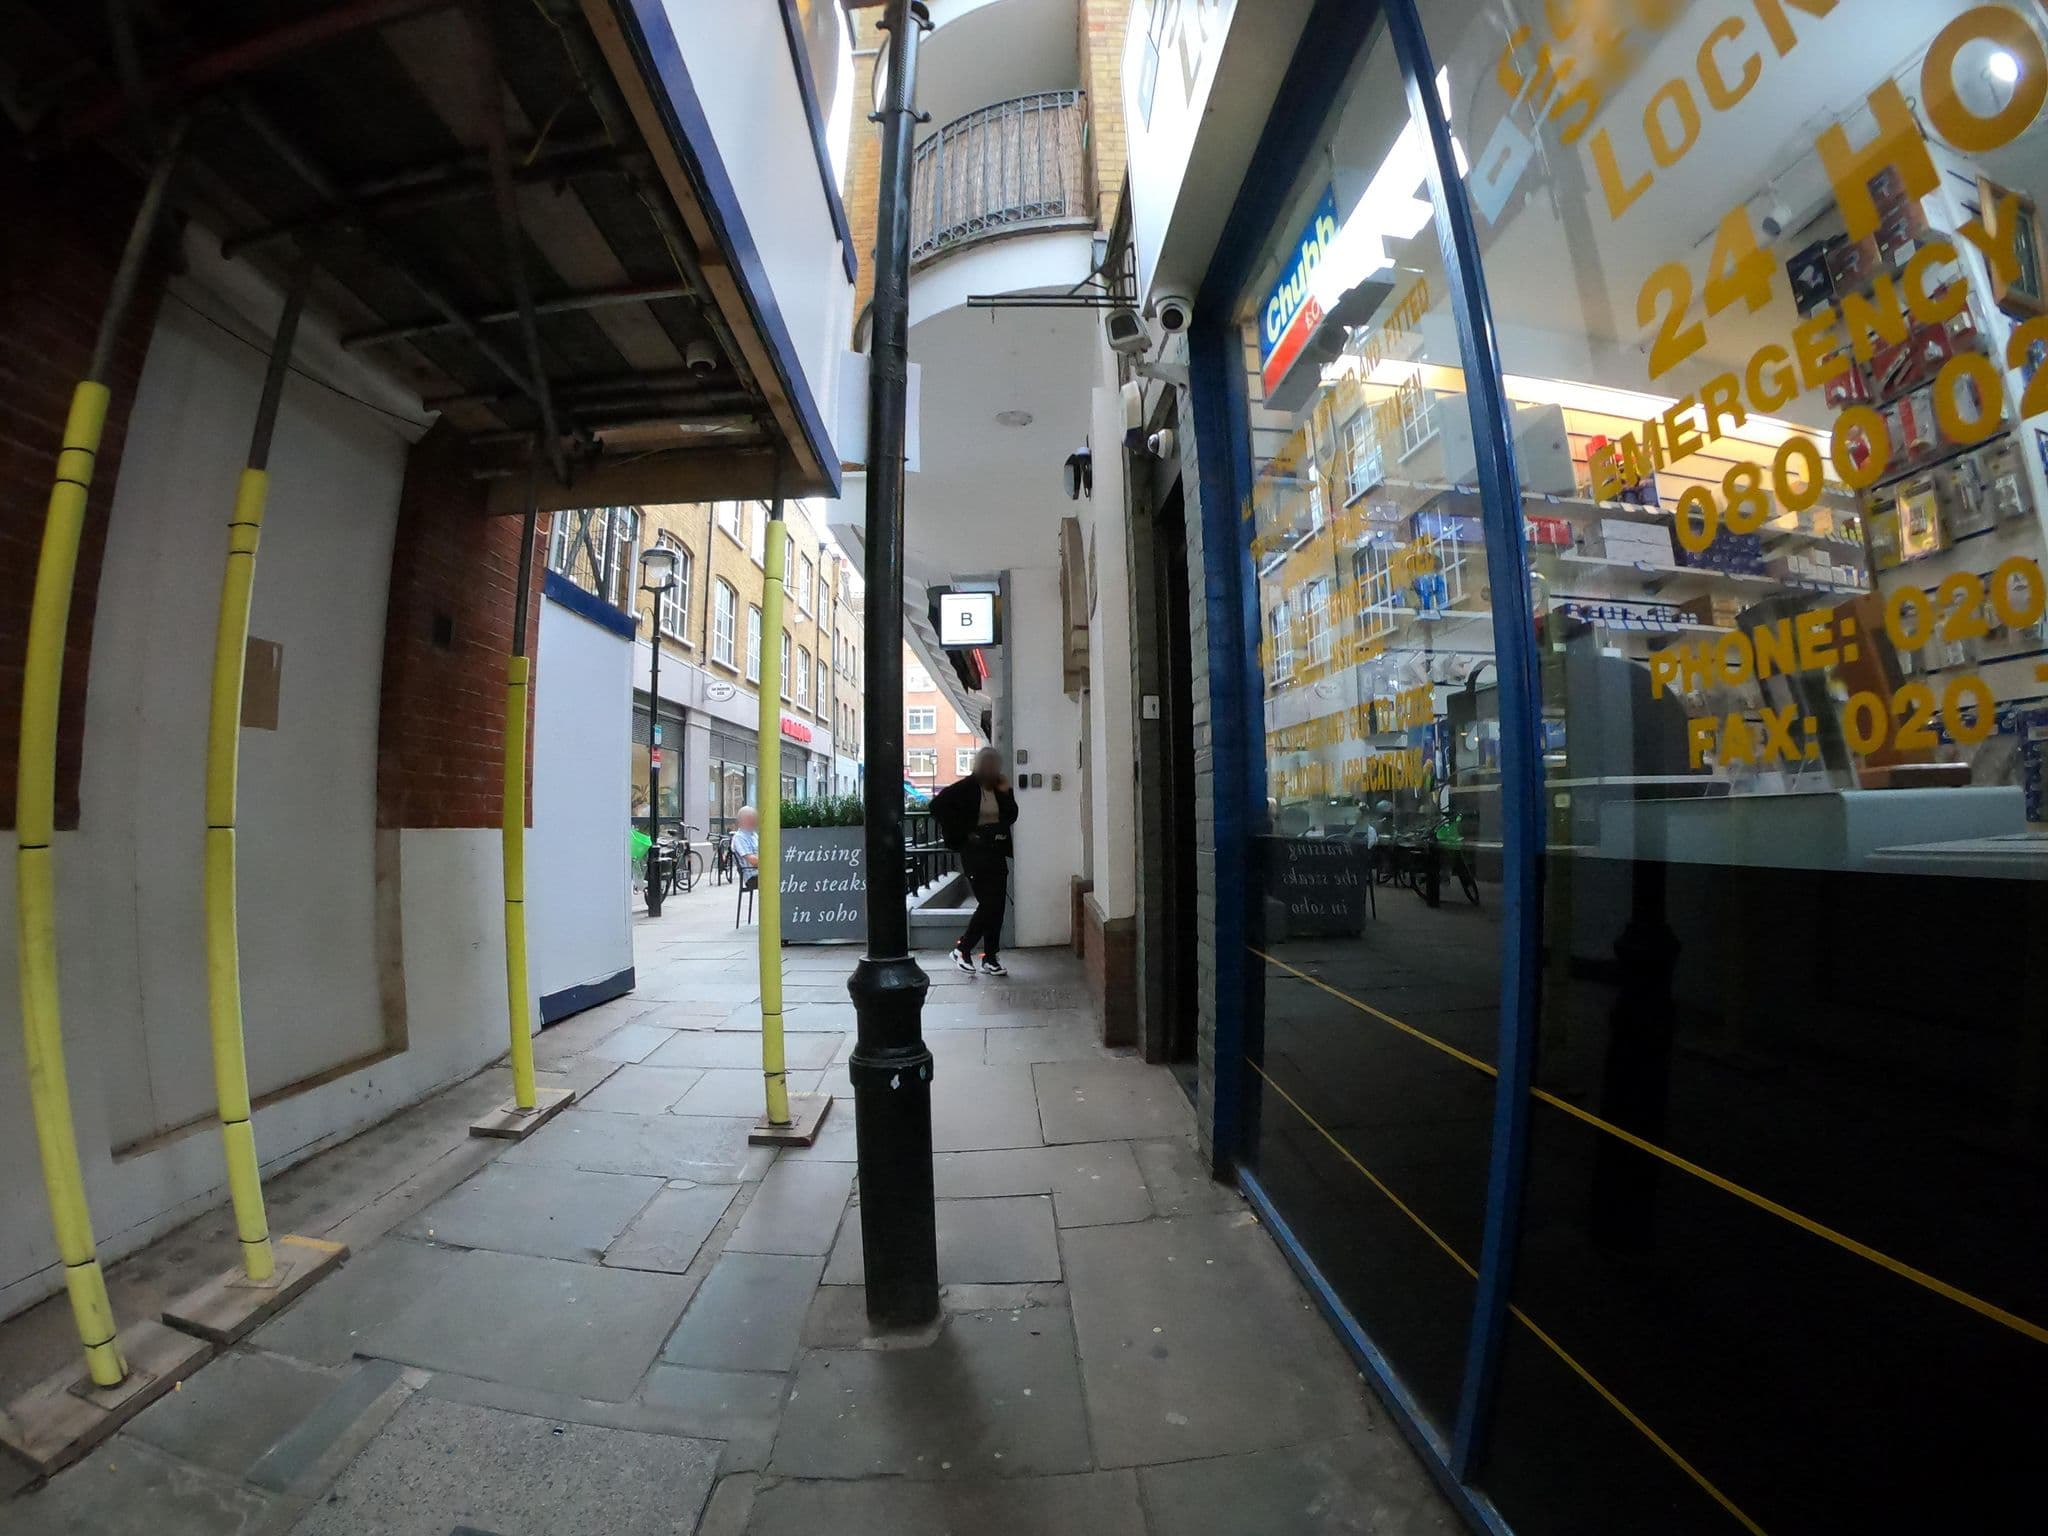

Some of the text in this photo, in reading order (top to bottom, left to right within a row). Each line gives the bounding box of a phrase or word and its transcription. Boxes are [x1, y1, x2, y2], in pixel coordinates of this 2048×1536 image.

[1637, 203, 1778, 381] 24
[1588, 190, 2020, 505] EMERGENCY
[1675, 406, 1890, 553] 0800
[960, 612, 973, 627] B
[1649, 555, 2045, 699] PHONE: 020
[1688, 674, 1996, 769] FAX: 020
[780, 872, 867, 893] the steaks
[784, 844, 862, 866] #raising
[792, 903, 858, 923] in soho
